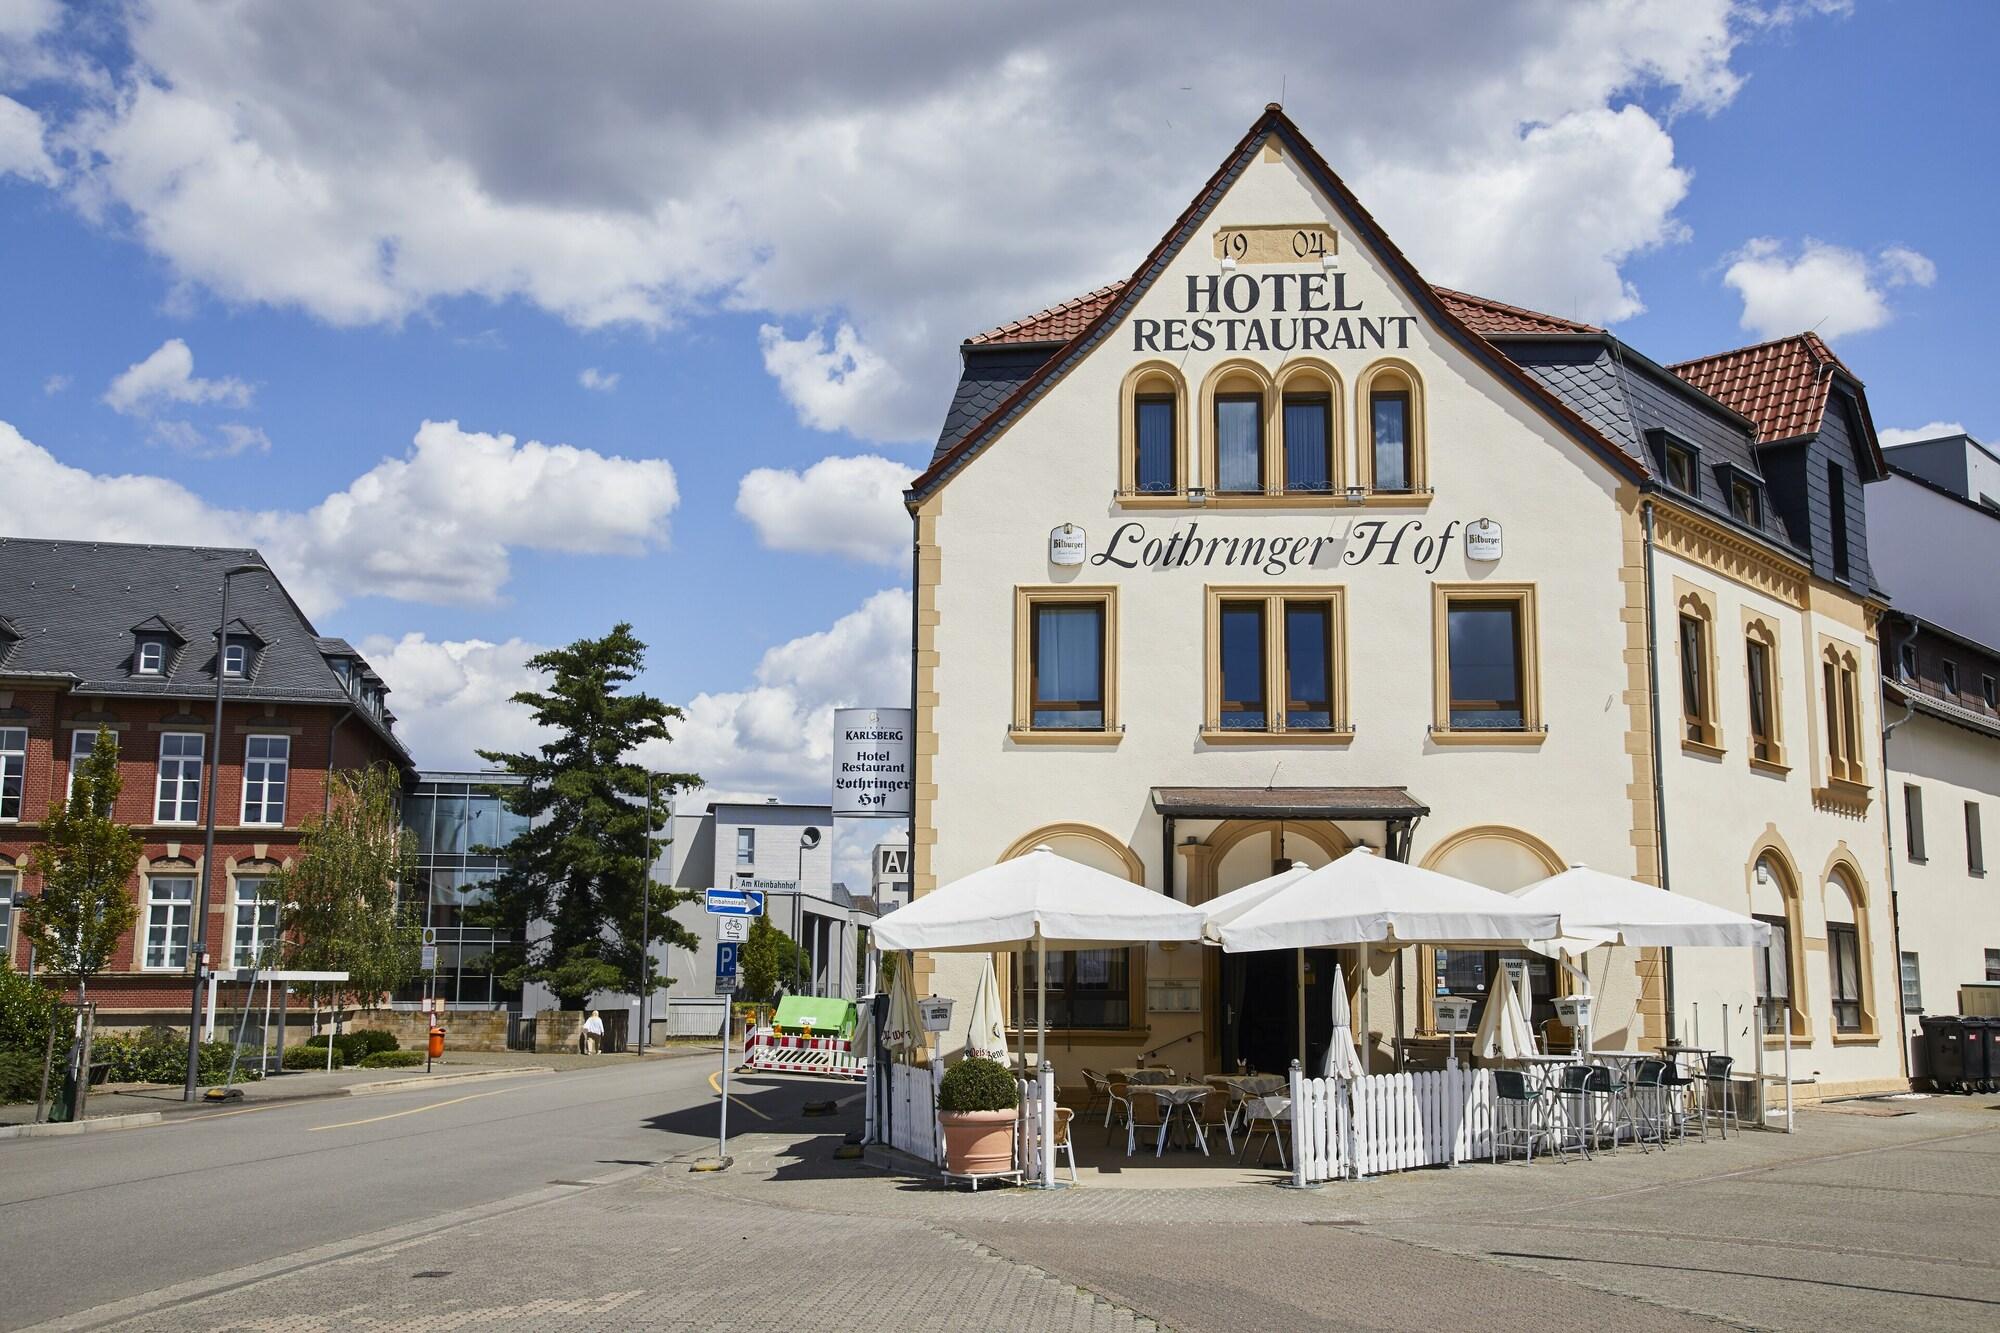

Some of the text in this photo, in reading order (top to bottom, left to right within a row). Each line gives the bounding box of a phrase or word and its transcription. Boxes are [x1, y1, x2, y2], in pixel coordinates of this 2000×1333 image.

[1219, 230, 1327, 260] 19 04
[1186, 272, 1364, 313] HOTEL
[1132, 316, 1418, 352] RESTAURANT
[1053, 538, 1084, 549] Bitburger
[1469, 534, 1500, 545] Bitburger
[1090, 520, 1460, 575] Lothringer Hof
[845, 730, 903, 740] KARLSBERG
[857, 751, 889, 761] Hotel
[842, 762, 904, 772] Restaurant
[836, 777, 911, 792] Lothringer
[858, 793, 887, 808] Hof
[741, 879, 796, 890] Am Kleinbahnhof
[721, 947, 733, 973] P
